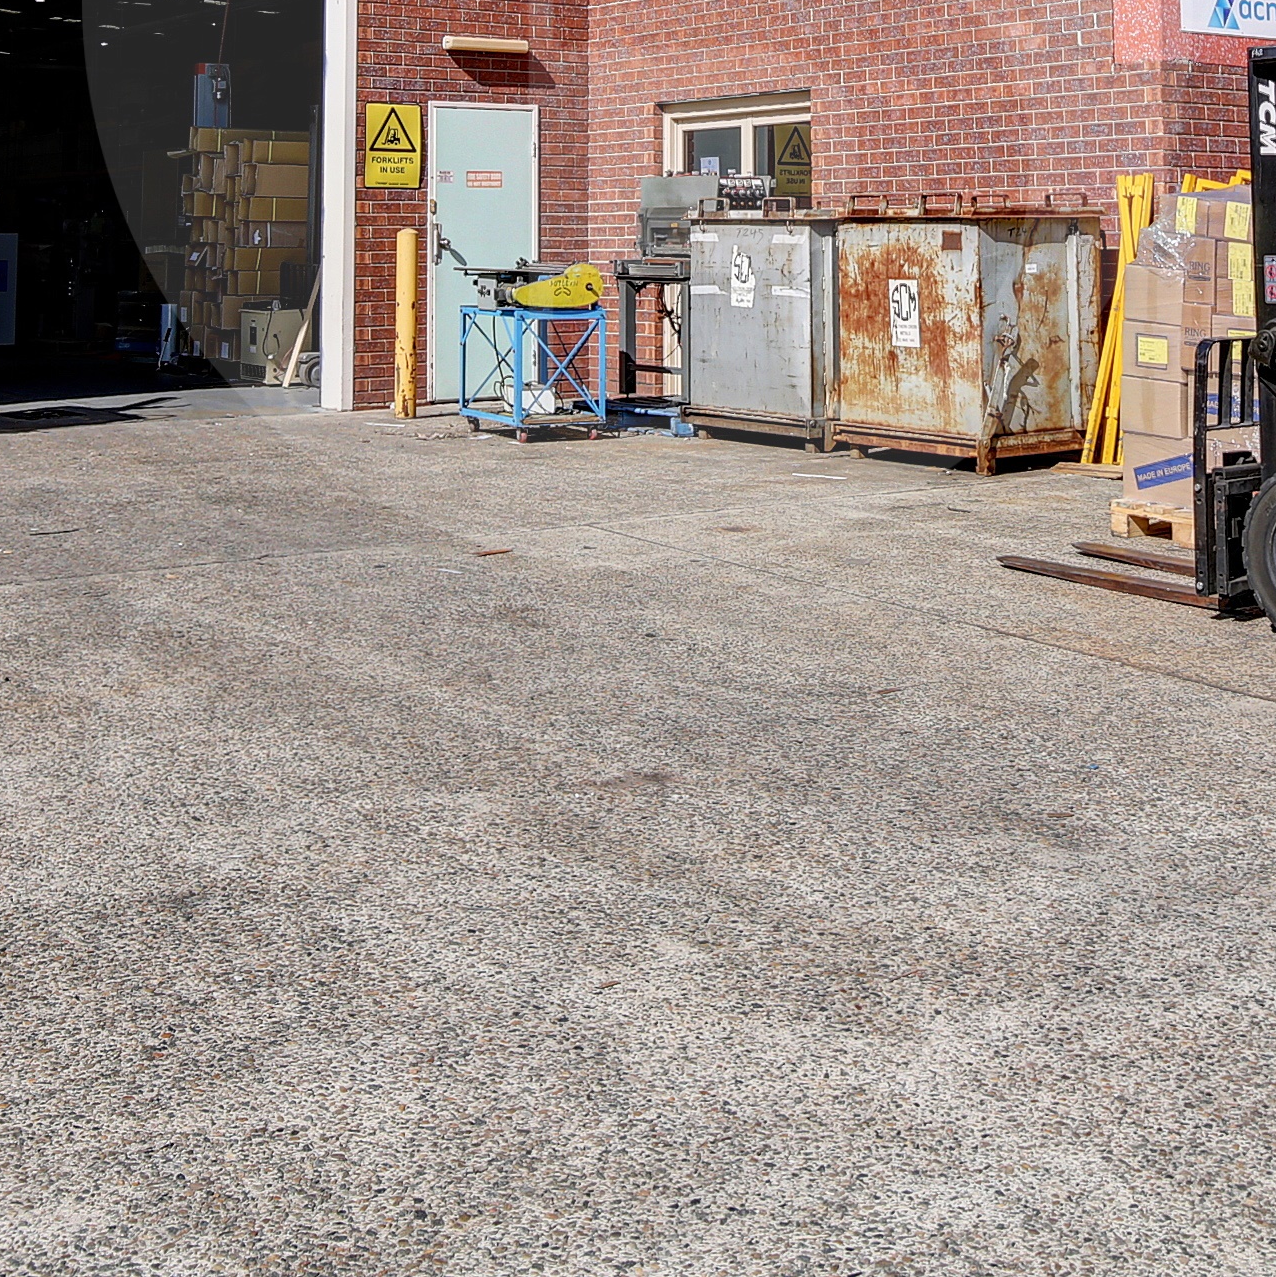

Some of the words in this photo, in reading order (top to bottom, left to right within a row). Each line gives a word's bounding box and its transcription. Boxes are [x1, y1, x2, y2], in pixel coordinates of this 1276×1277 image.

[371, 156, 414, 164] FORKLIFTS
[389, 166, 406, 174] USE
[1189, 261, 1211, 271] RING
[891, 283, 917, 321] SCM
[1184, 327, 1207, 337] RING
[1137, 470, 1156, 481] MADE
[1156, 469, 1164, 477] IN
[1164, 462, 1191, 475] EUROPE
